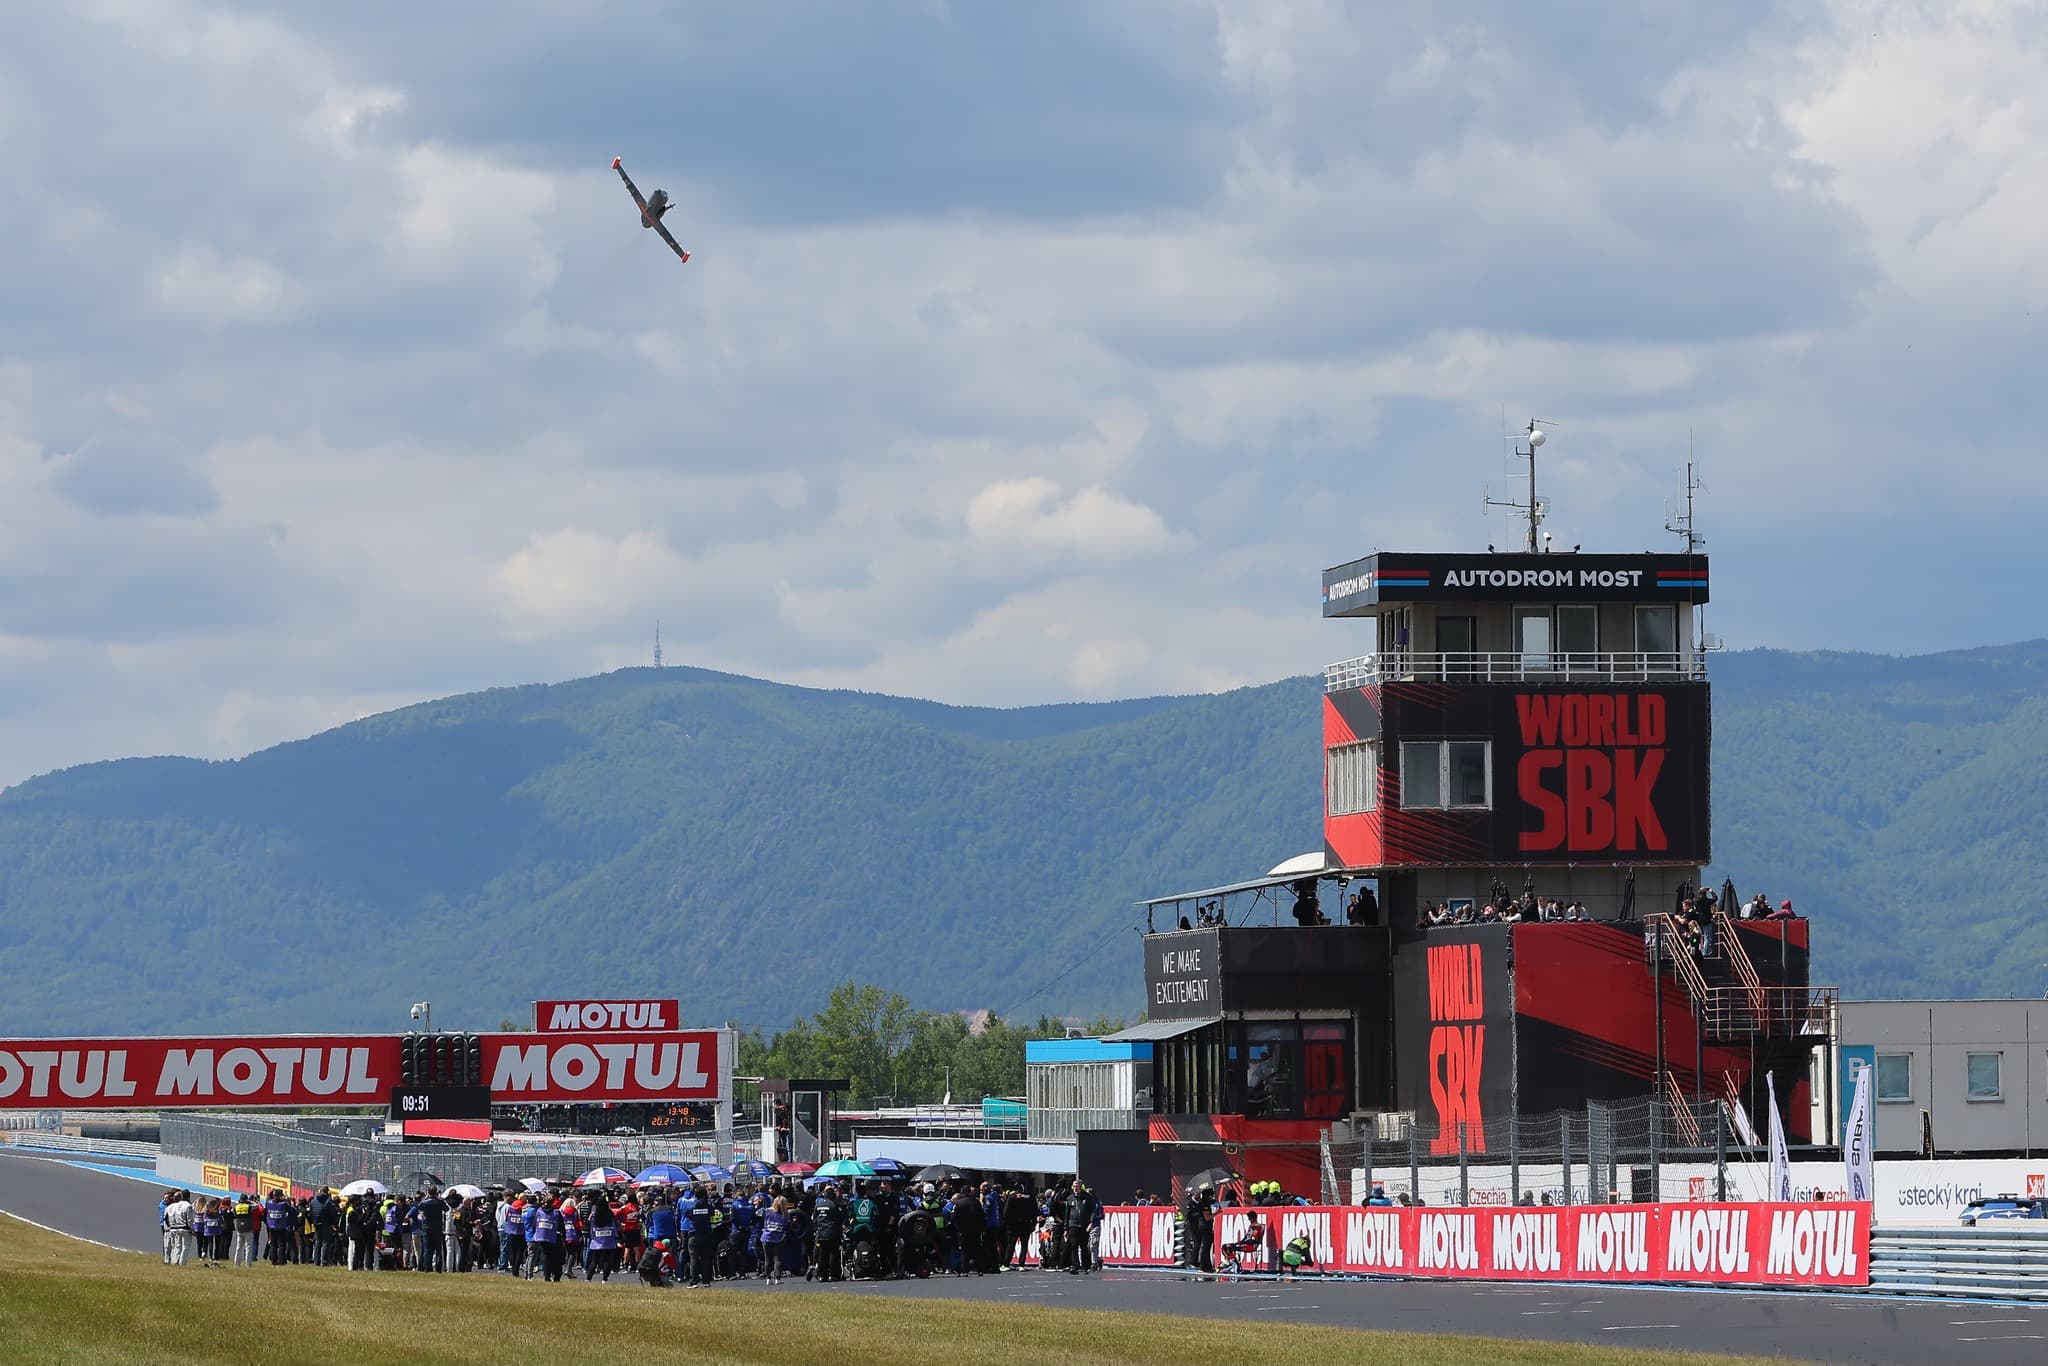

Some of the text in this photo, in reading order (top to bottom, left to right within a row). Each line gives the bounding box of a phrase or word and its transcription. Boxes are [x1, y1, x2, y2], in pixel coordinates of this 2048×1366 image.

[1329, 571, 1373, 602] AUTODROM MOST
[1444, 570, 1643, 587] AUTODROM MOST
[1515, 694, 1666, 746] WORLD
[1517, 749, 1668, 851] SBK
[1162, 949, 1201, 974] WE MAKE
[1427, 943, 1484, 1022] WORLD
[549, 1003, 666, 1029] MOTUL
[1156, 978, 1209, 1004] EXCITEMENT
[155, 1047, 378, 1096] MOTUL
[490, 1043, 709, 1092] MOTUL
[1429, 1023, 1487, 1156] SBK
[402, 1095, 430, 1112] 09:51
[1099, 1211, 1141, 1260] MOTUL
[1346, 1212, 1404, 1268] MOTUL
[1418, 1213, 1479, 1271] MOTUL
[1492, 1213, 1561, 1273] MOTUL
[1576, 1212, 1649, 1273] MOTUL
[1667, 1209, 1750, 1274] MOTUL
[1766, 1208, 1857, 1277] MOTUL
